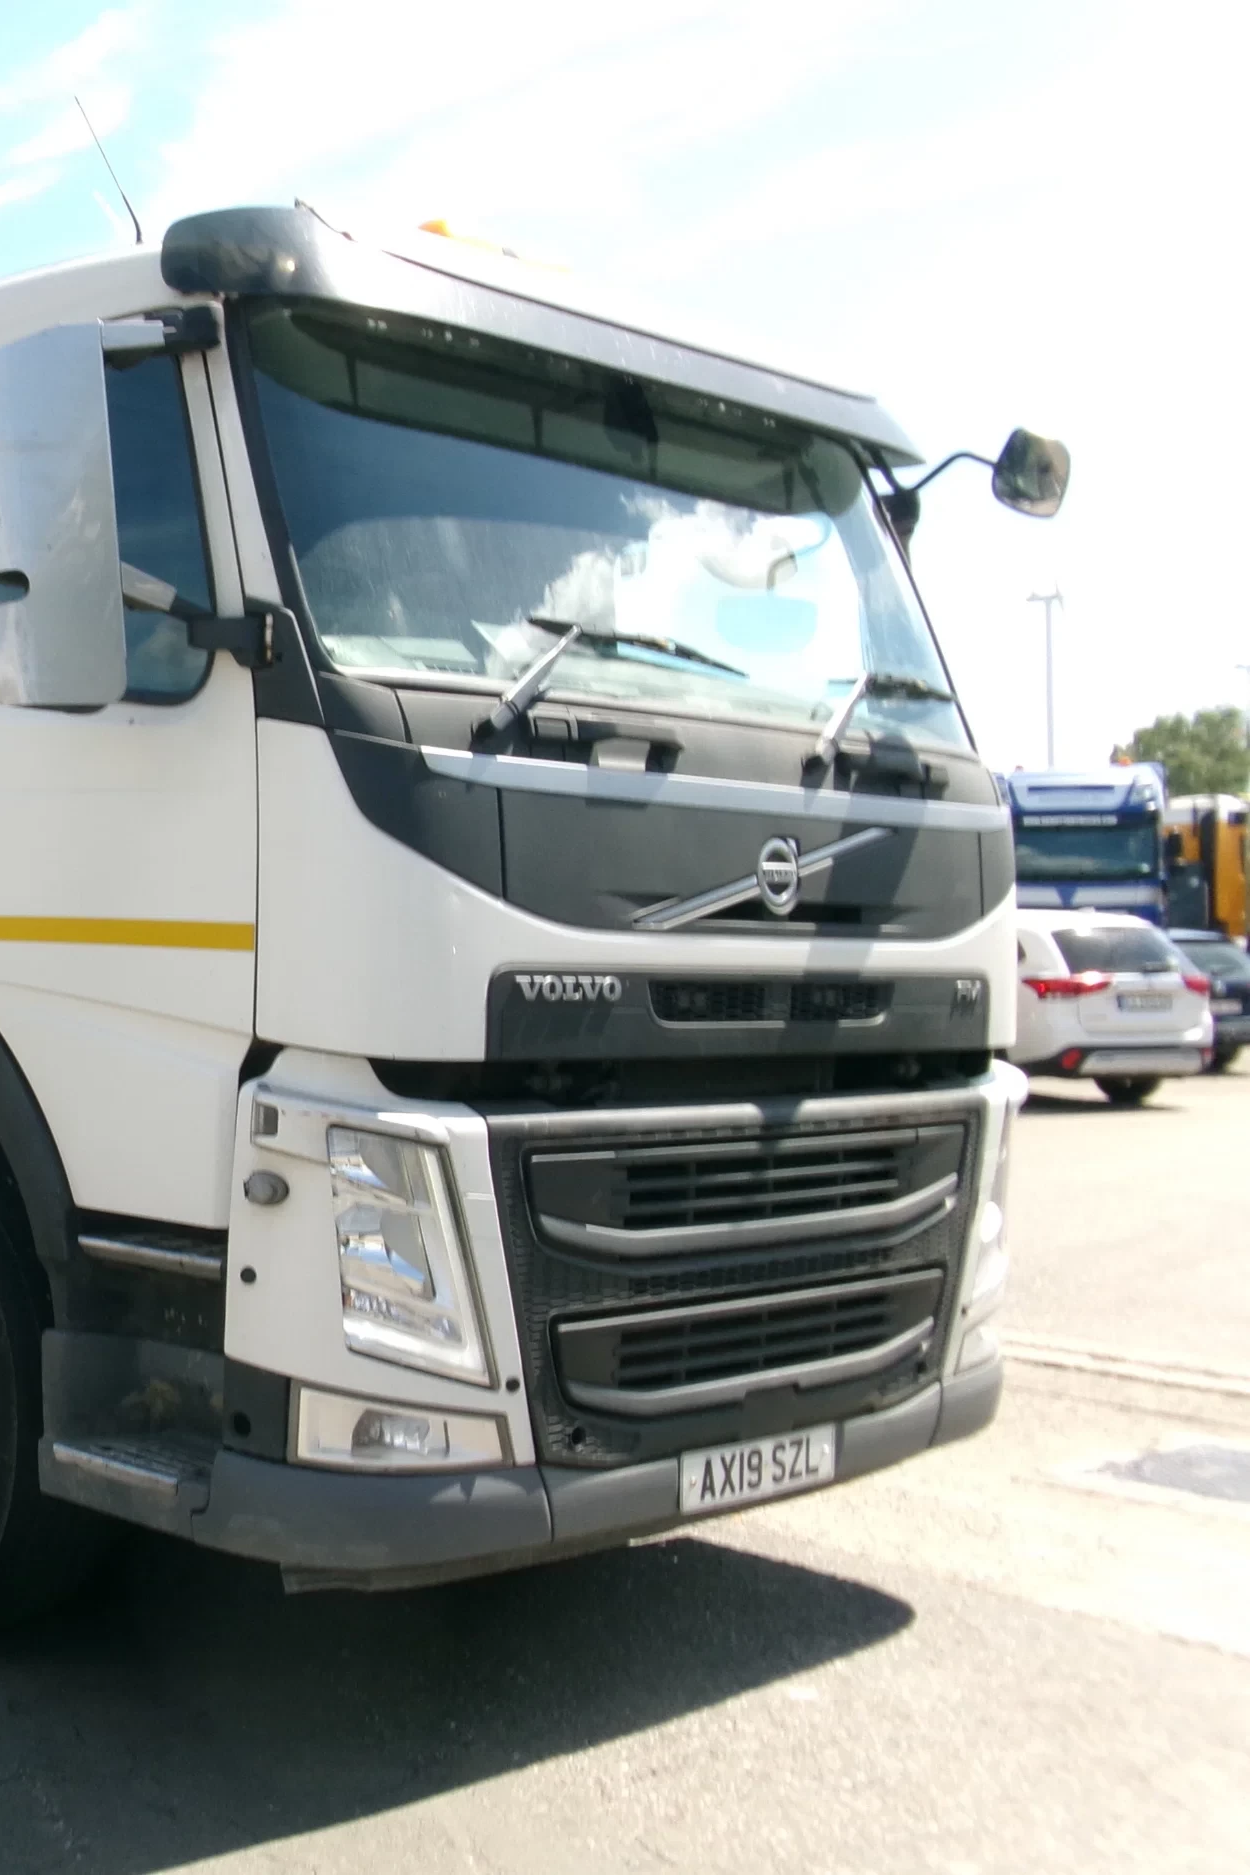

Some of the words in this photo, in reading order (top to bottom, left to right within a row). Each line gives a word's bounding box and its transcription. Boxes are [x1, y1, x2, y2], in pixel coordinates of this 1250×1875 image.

[515, 975, 622, 1002] VOLVO
[701, 1449, 763, 1501] AX19
[772, 1436, 819, 1483] SZL
